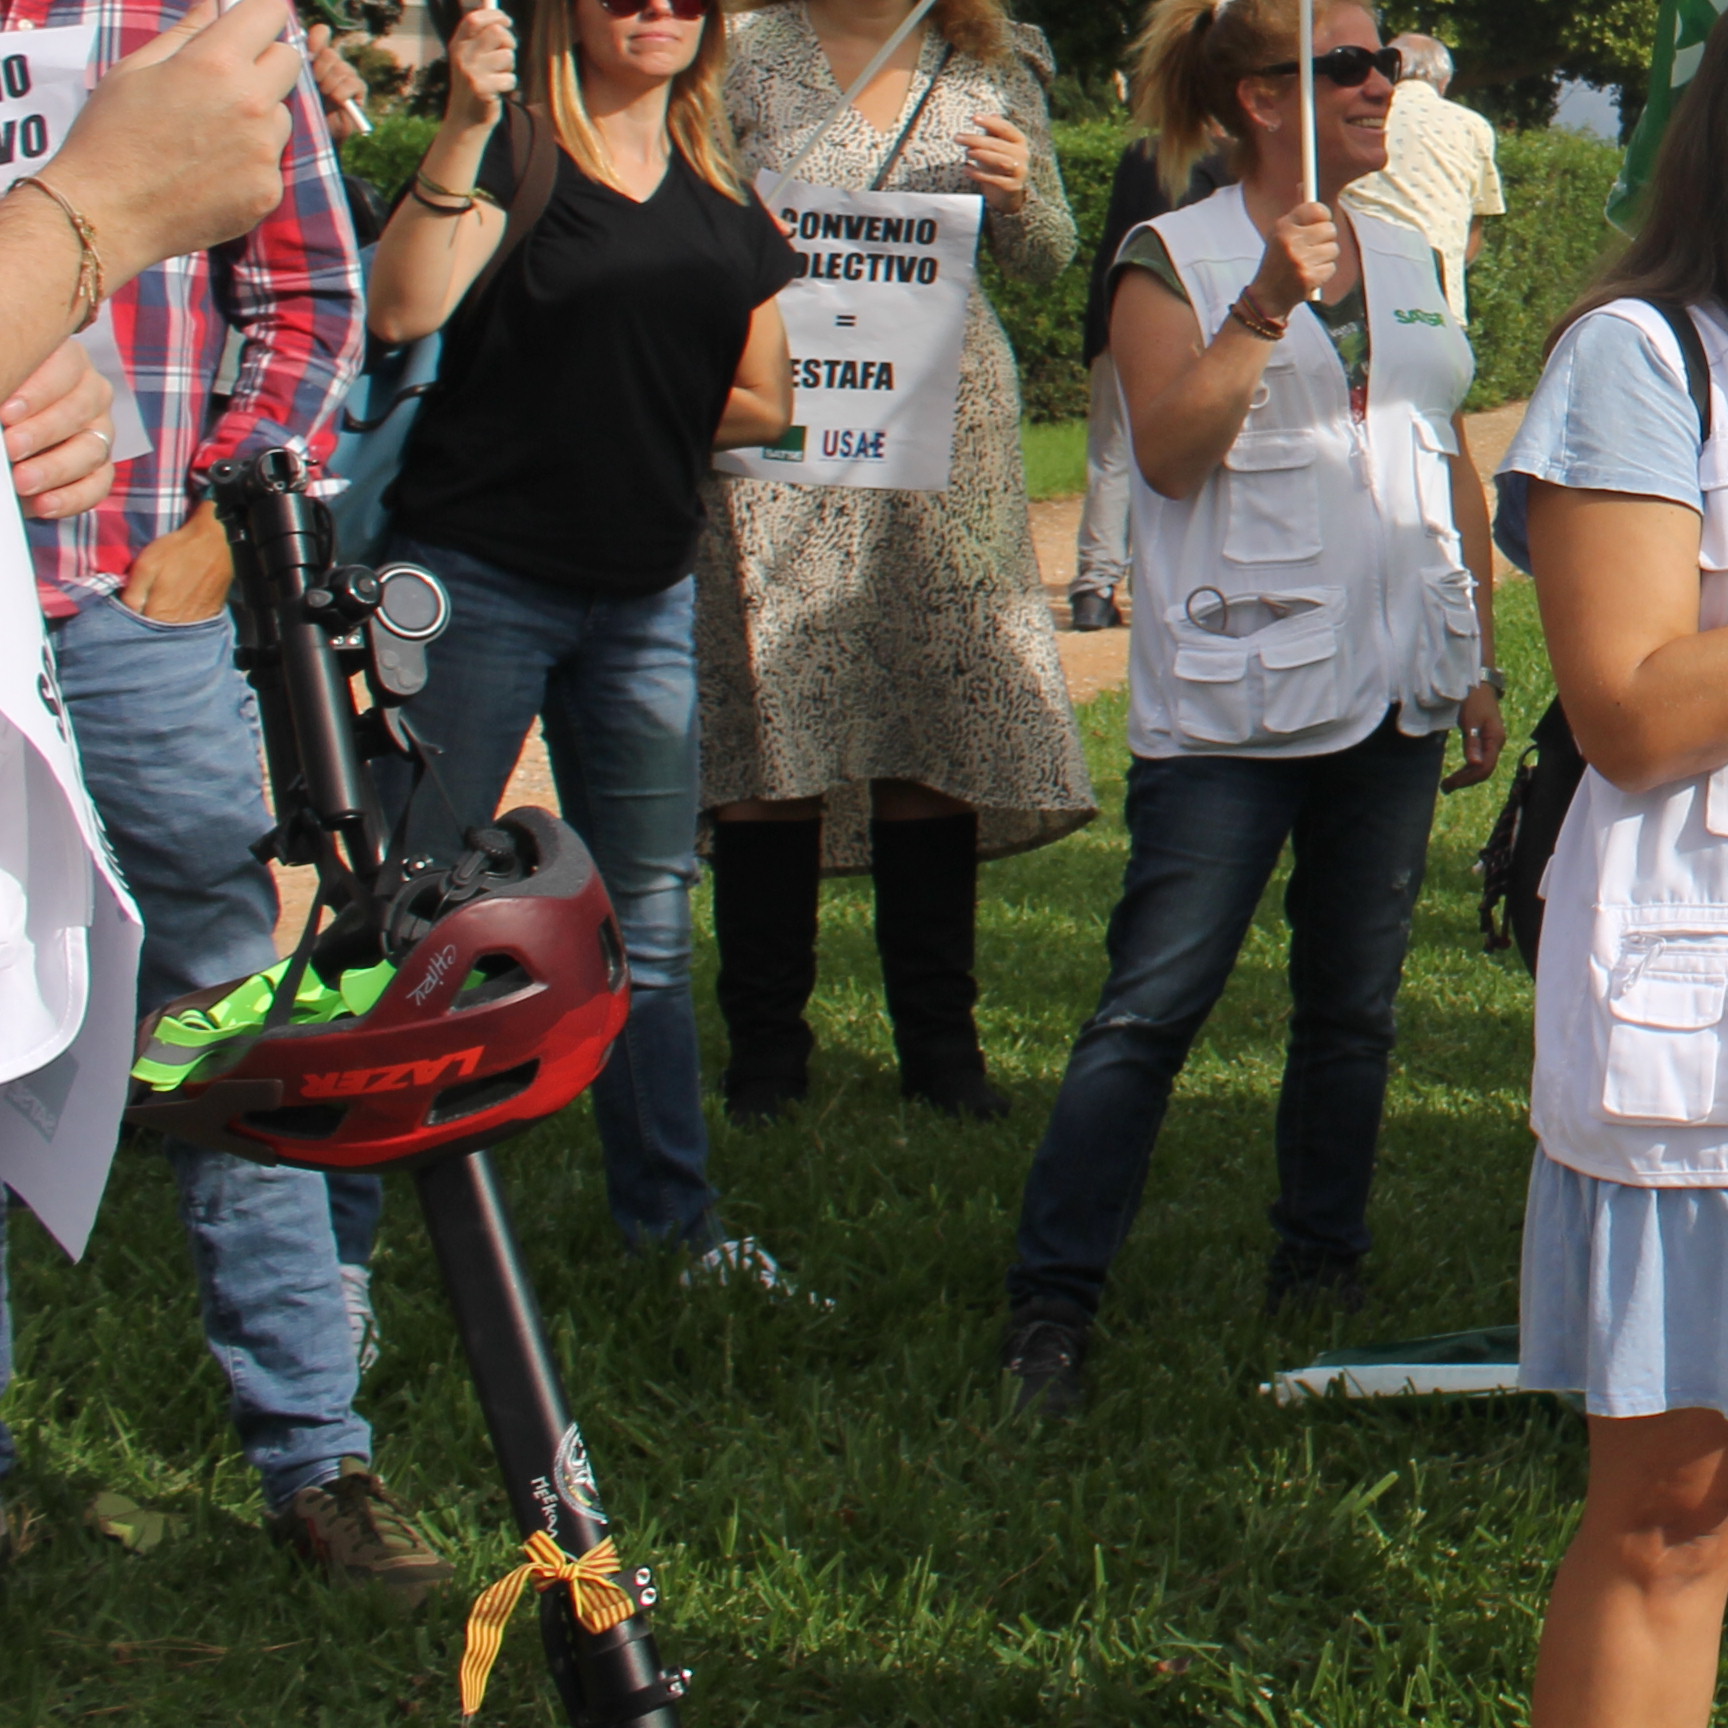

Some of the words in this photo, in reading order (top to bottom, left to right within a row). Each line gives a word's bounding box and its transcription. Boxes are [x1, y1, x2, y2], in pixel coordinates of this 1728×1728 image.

[781, 207, 938, 246] CONVENIO
[796, 251, 939, 285] OLECTIVO
[790, 357, 894, 391] ESTAFA
[299, 1044, 486, 1099] LAZER
